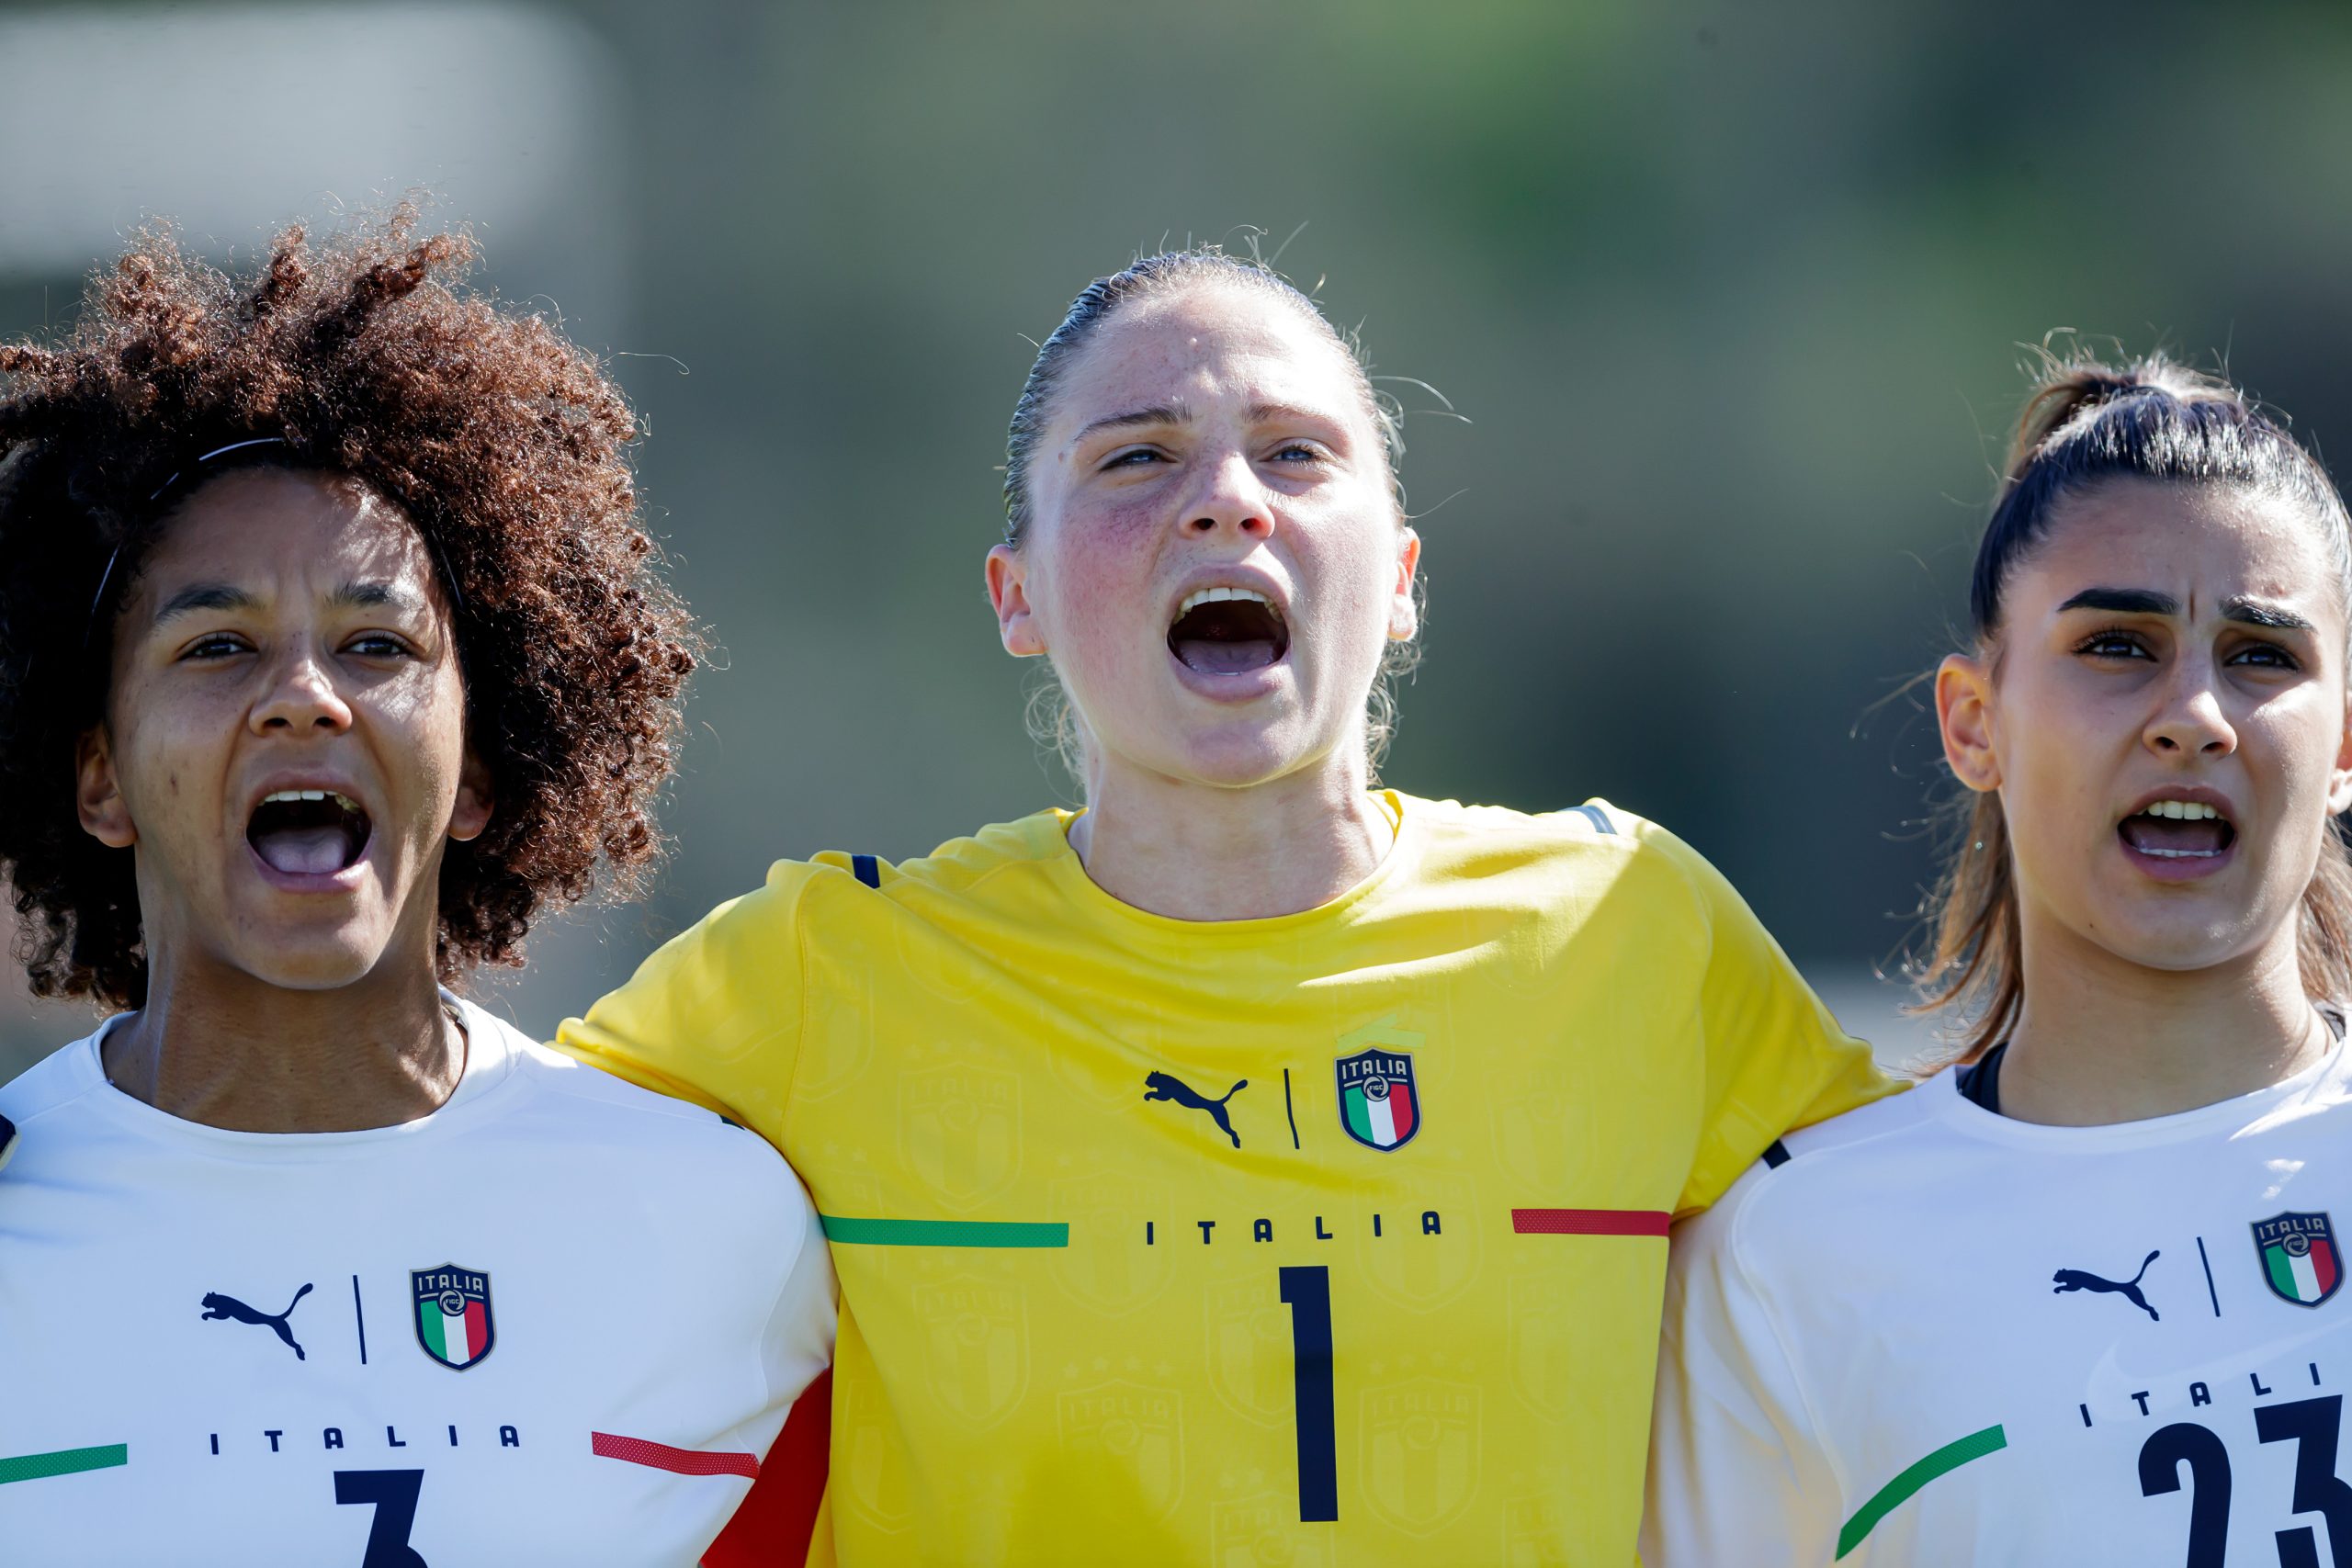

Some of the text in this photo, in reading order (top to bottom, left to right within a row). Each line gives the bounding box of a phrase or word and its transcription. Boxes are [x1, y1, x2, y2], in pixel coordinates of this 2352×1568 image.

[1342, 1059, 1407, 1079] ITALIA
[1147, 1211, 1442, 1246] ITALIA
[2258, 1217, 2325, 1239] ITALIA
[418, 1274, 483, 1292] ITALIA
[1279, 1265, 1339, 1523] 1
[209, 1425, 520, 1455] ITALIA
[2138, 1394, 2352, 1568] 23
